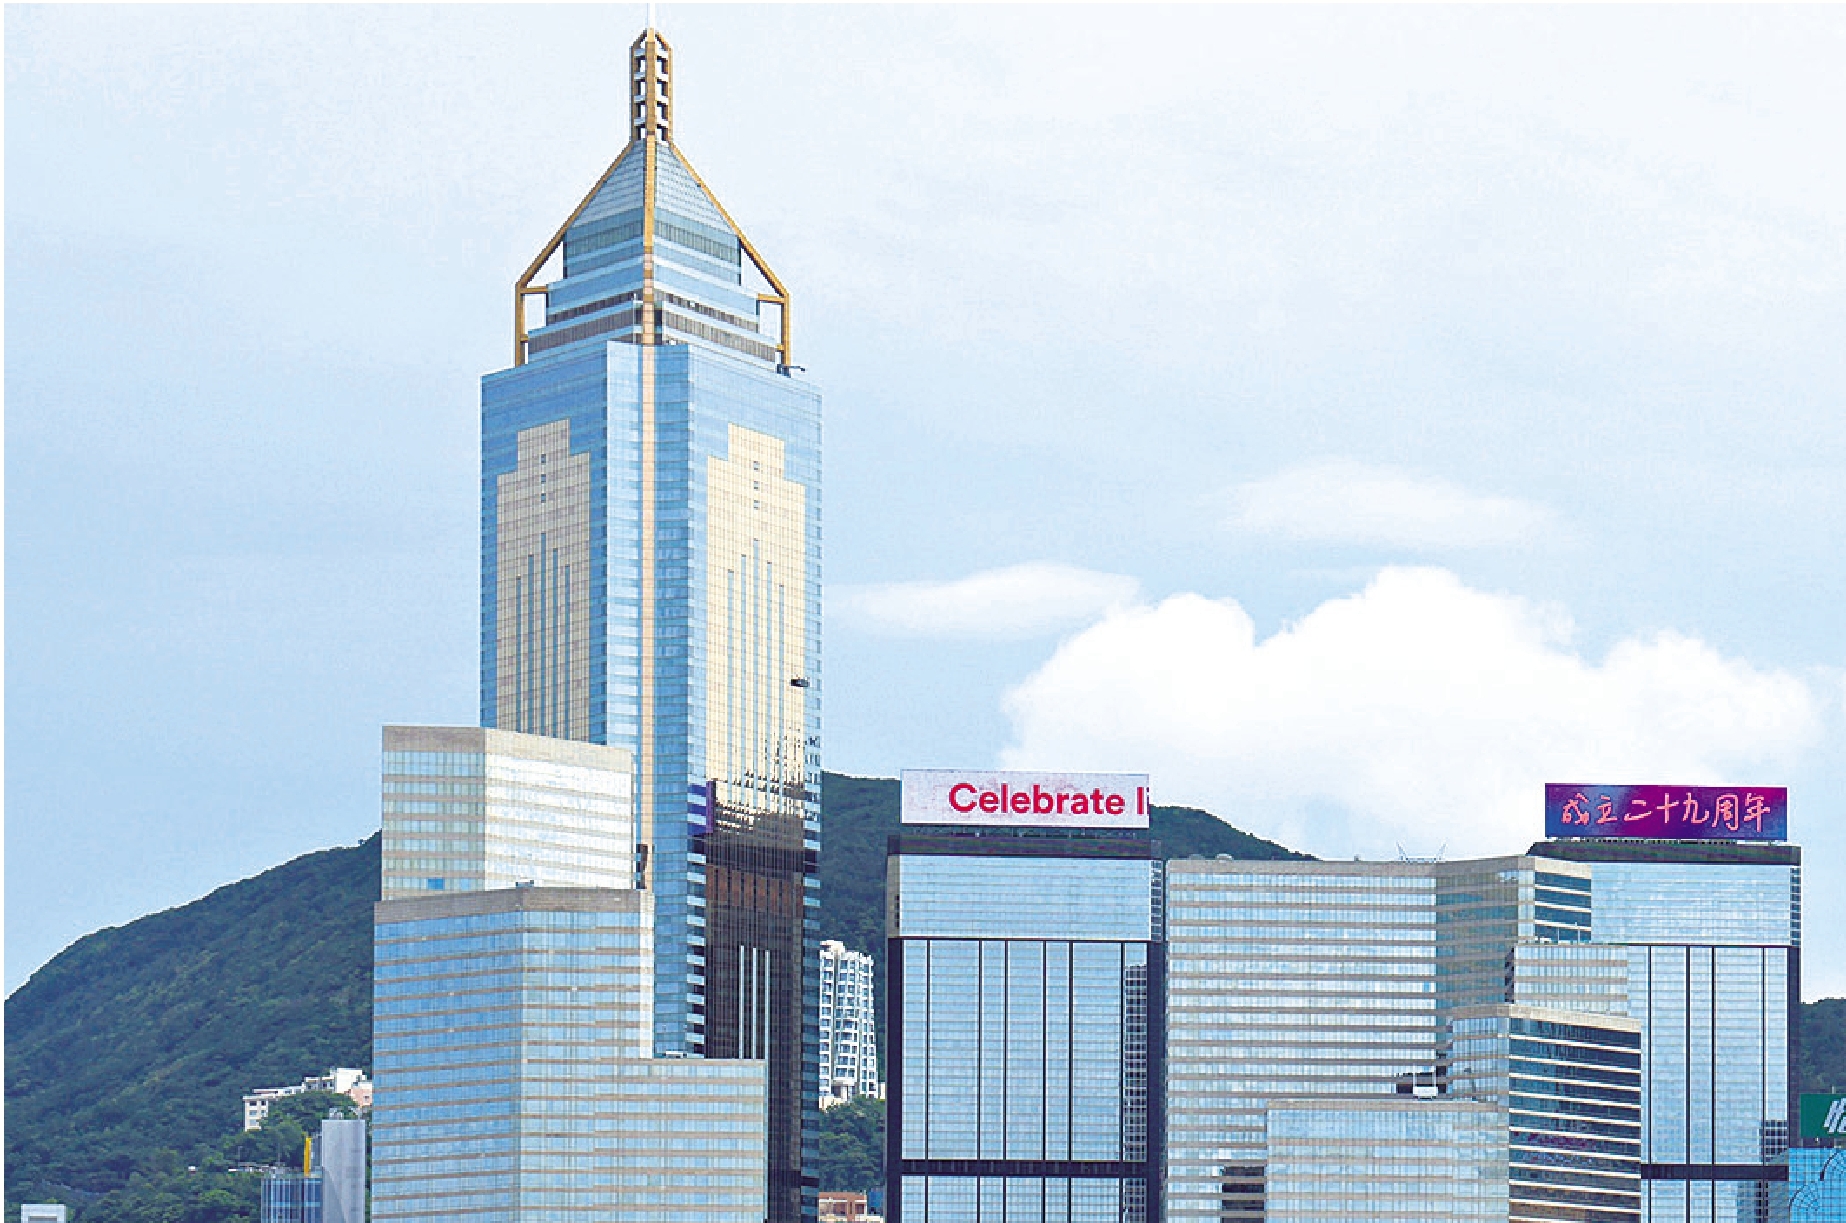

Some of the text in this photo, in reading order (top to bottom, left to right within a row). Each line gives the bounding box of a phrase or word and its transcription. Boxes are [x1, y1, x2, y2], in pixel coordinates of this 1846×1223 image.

[948, 782, 1126, 815] Celebrate
[1561, 792, 1772, 832] 成立二十九周年
